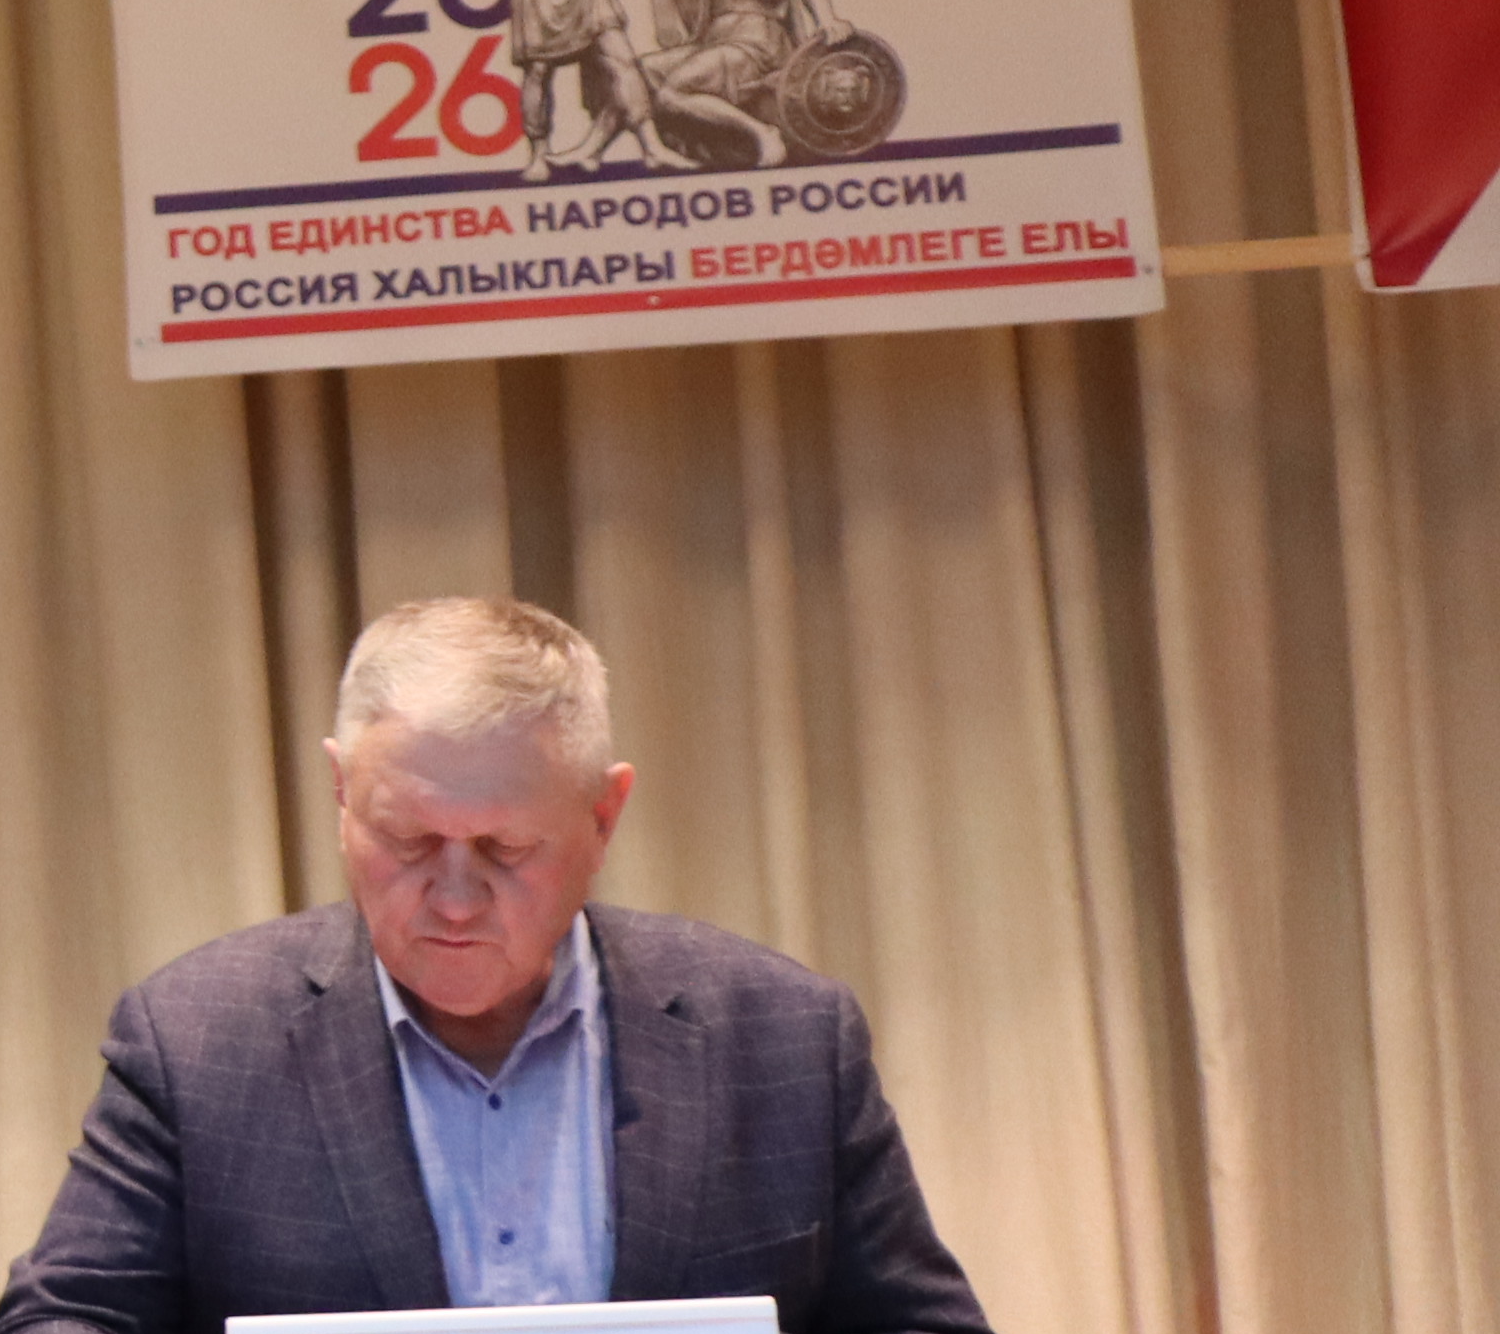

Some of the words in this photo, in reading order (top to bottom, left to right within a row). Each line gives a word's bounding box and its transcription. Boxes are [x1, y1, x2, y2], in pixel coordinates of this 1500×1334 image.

[347, 33, 526, 162] 26
[167, 223, 256, 259] ГОД
[268, 208, 514, 254] ЕДИНСТВА
[528, 188, 753, 234] НАРОДОВ
[770, 171, 967, 214] РОССИИ
[172, 272, 359, 313] РОССИЯ
[372, 251, 675, 300] ХАЛЫКЛАРЫ
[691, 226, 1005, 279] БЕРДӘМЛЕГЕ
[1022, 218, 1129, 254] ЕЛЫ
